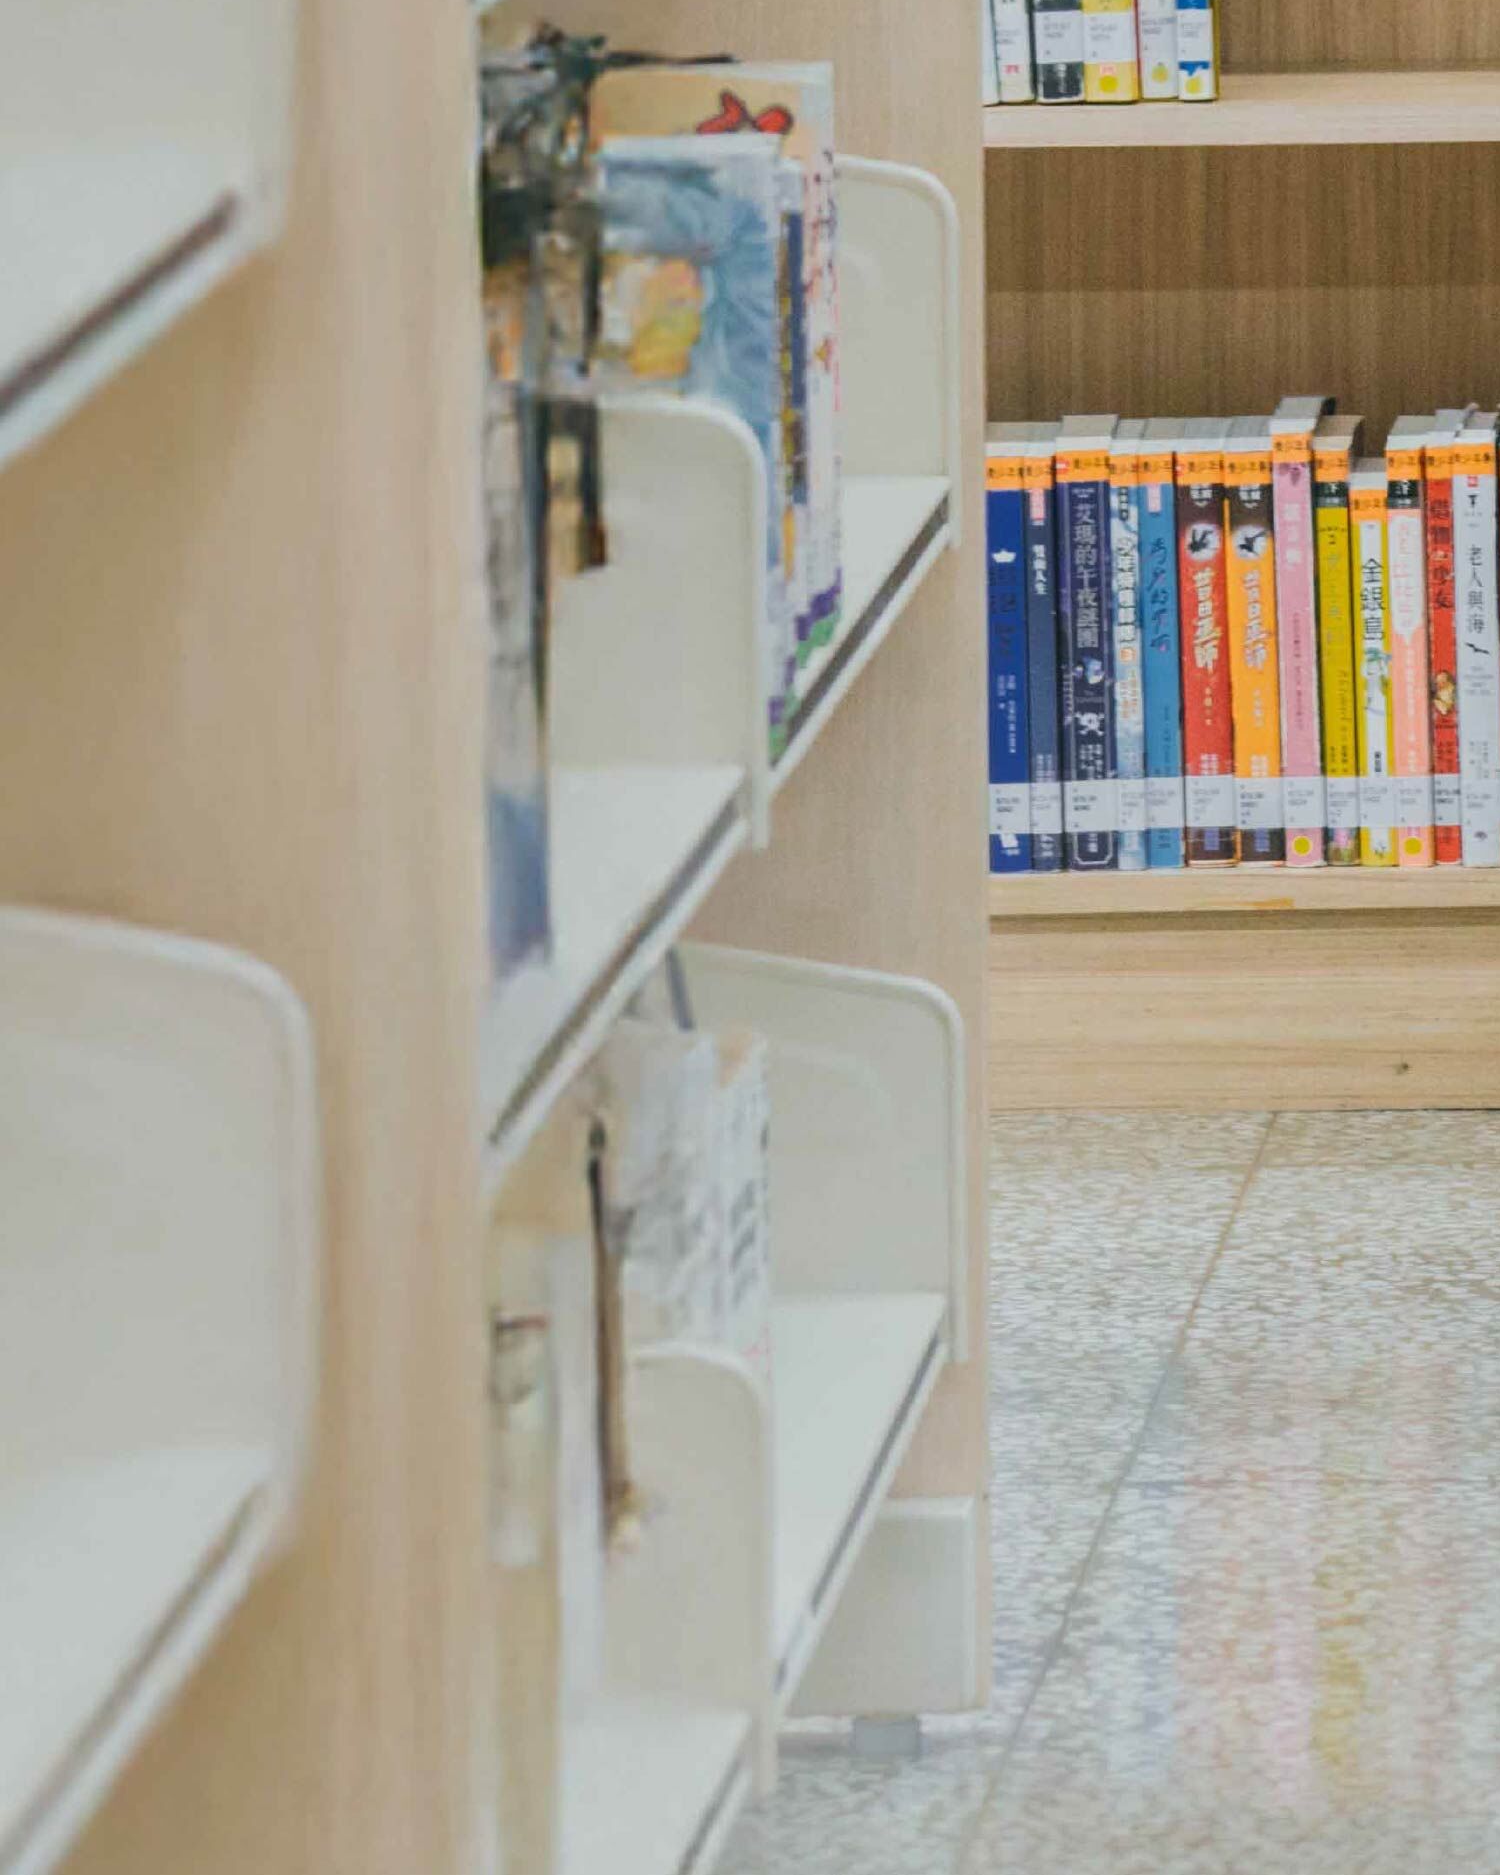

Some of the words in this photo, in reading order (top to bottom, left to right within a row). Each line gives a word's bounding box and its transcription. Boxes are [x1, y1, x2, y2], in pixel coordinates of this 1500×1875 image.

[1360, 556, 1387, 643] 金銀島
[1467, 543, 1487, 635] 老人與海
